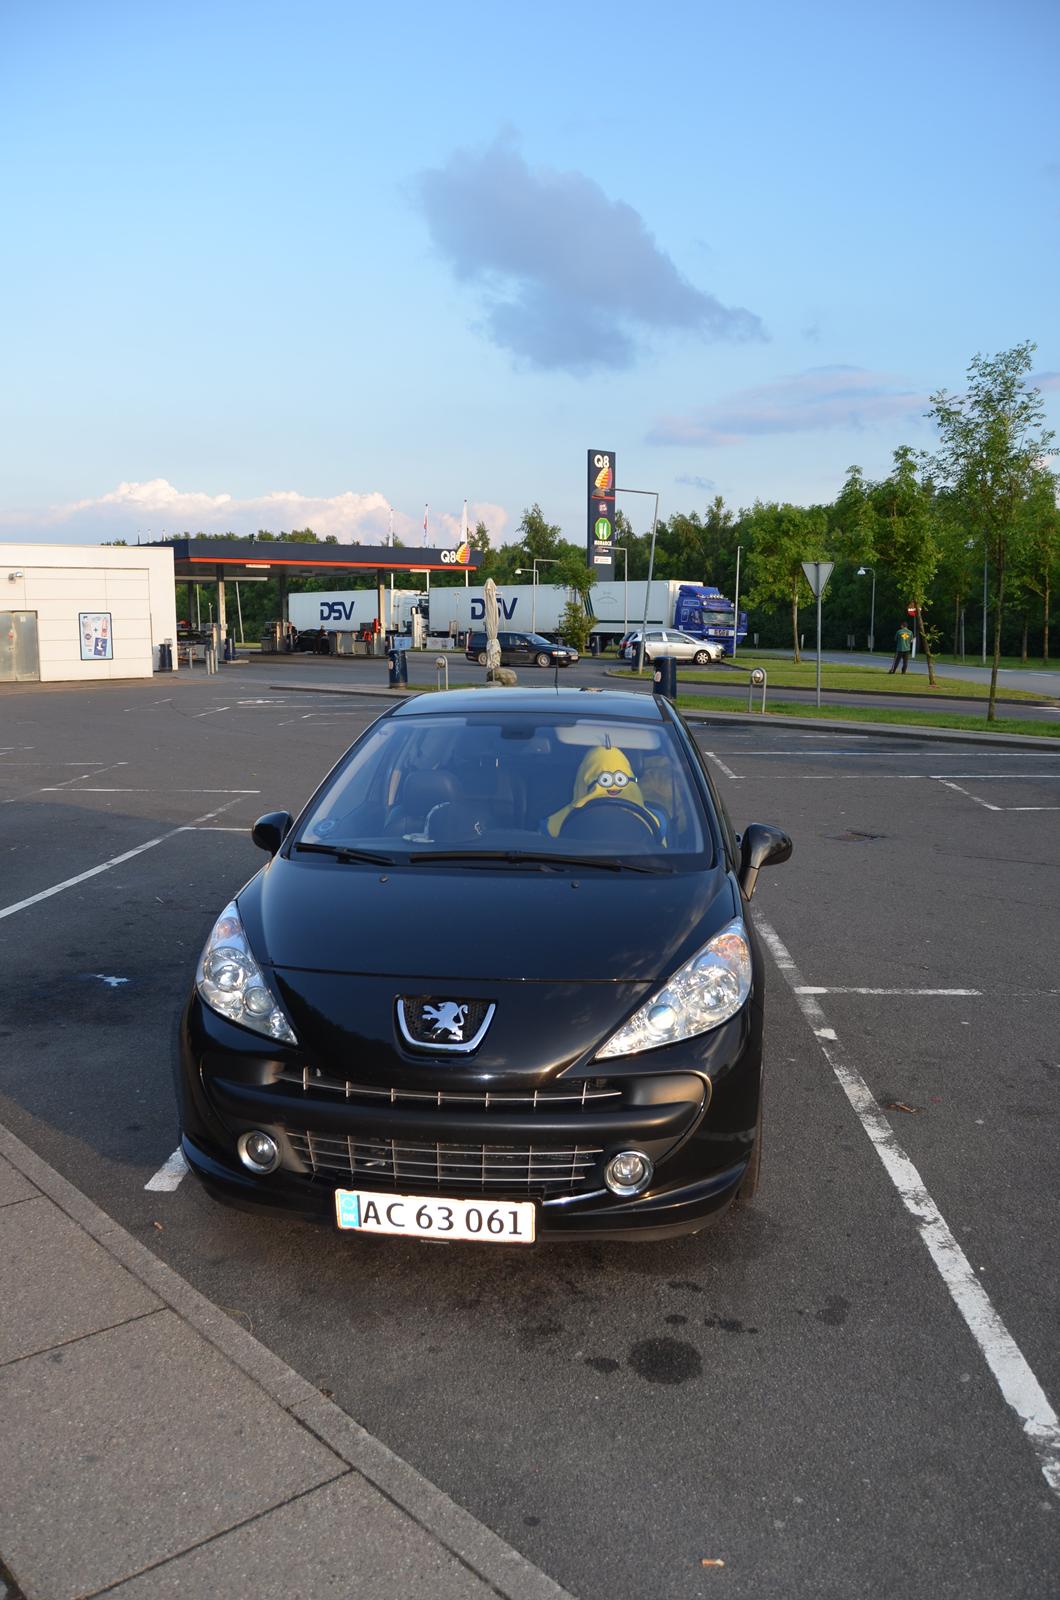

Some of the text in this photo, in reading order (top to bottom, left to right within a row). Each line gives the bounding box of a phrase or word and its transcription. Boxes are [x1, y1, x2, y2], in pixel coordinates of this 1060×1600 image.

[594, 454, 610, 468] Q8
[440, 550, 457, 563] Q8
[320, 601, 355, 620] DSV
[471, 597, 518, 620] DV
[363, 1200, 522, 1235] AC 63 061
